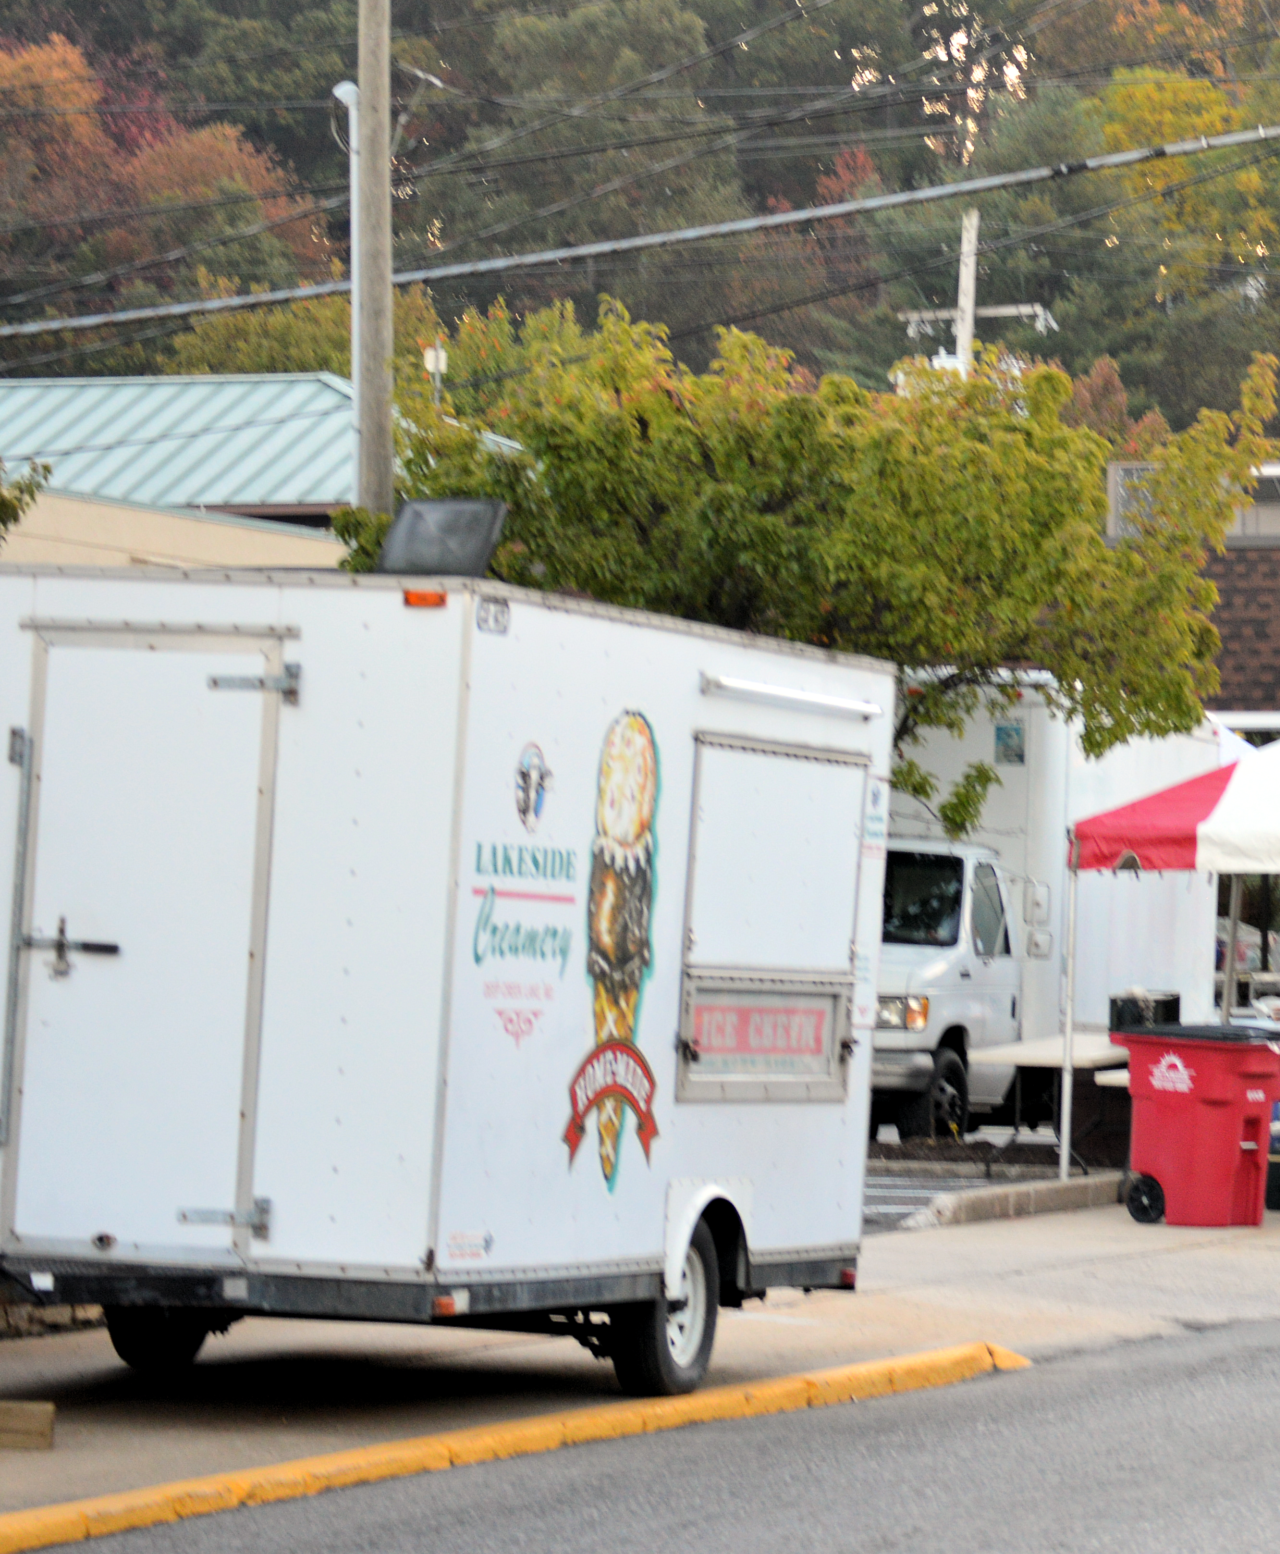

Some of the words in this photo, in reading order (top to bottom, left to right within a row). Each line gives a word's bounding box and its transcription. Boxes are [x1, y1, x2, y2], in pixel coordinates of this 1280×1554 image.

[475, 840, 577, 883] LAKESIDE
[473, 884, 573, 981] Creamery
[702, 1011, 738, 1048] ICE
[749, 1012, 818, 1050] CREAM
